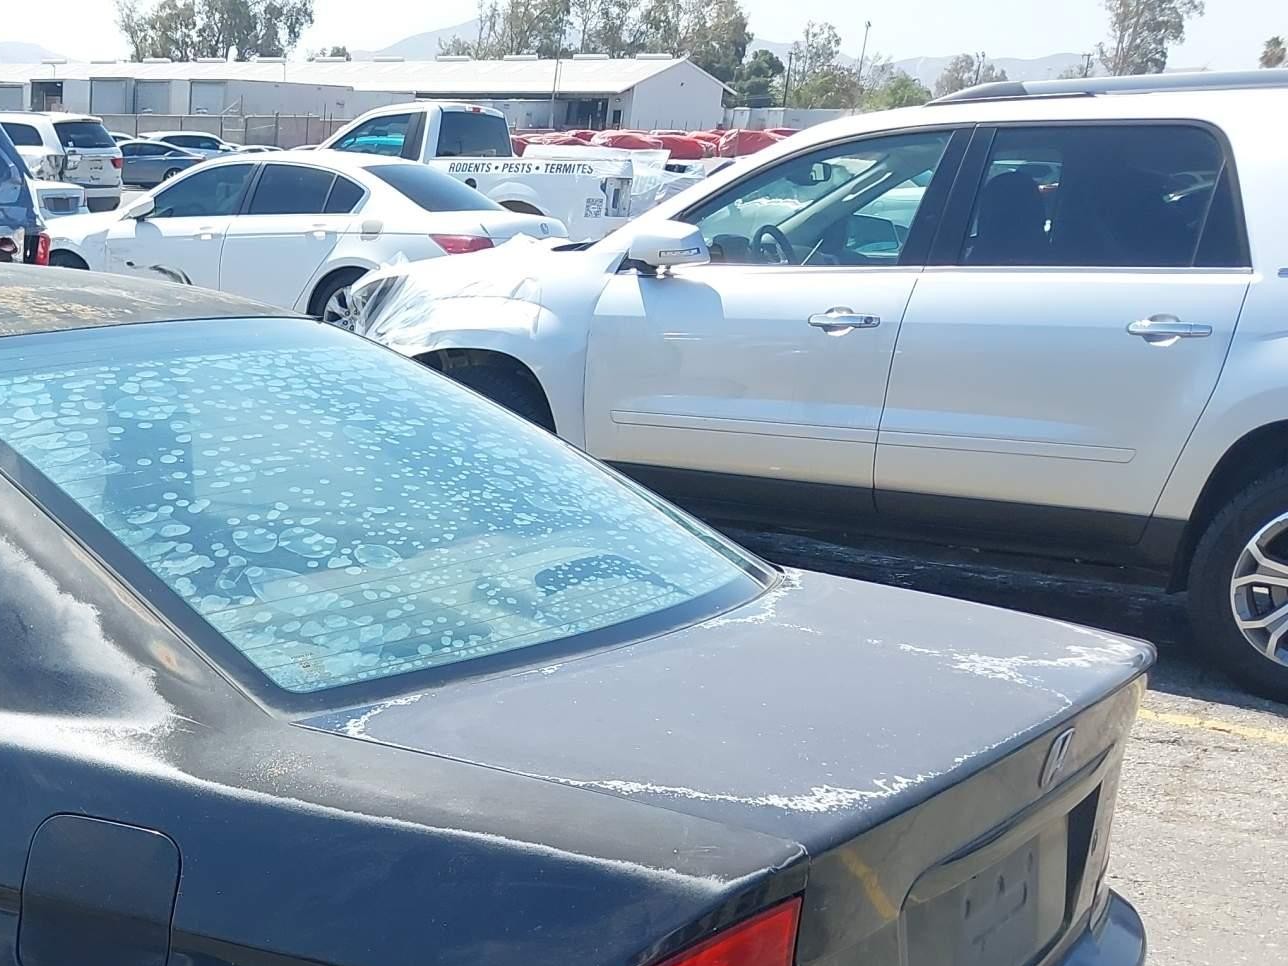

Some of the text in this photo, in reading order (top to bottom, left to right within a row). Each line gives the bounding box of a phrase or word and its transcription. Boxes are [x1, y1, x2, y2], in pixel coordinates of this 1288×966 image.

[448, 162, 594, 175] RODENTS PESTS TERMITES
